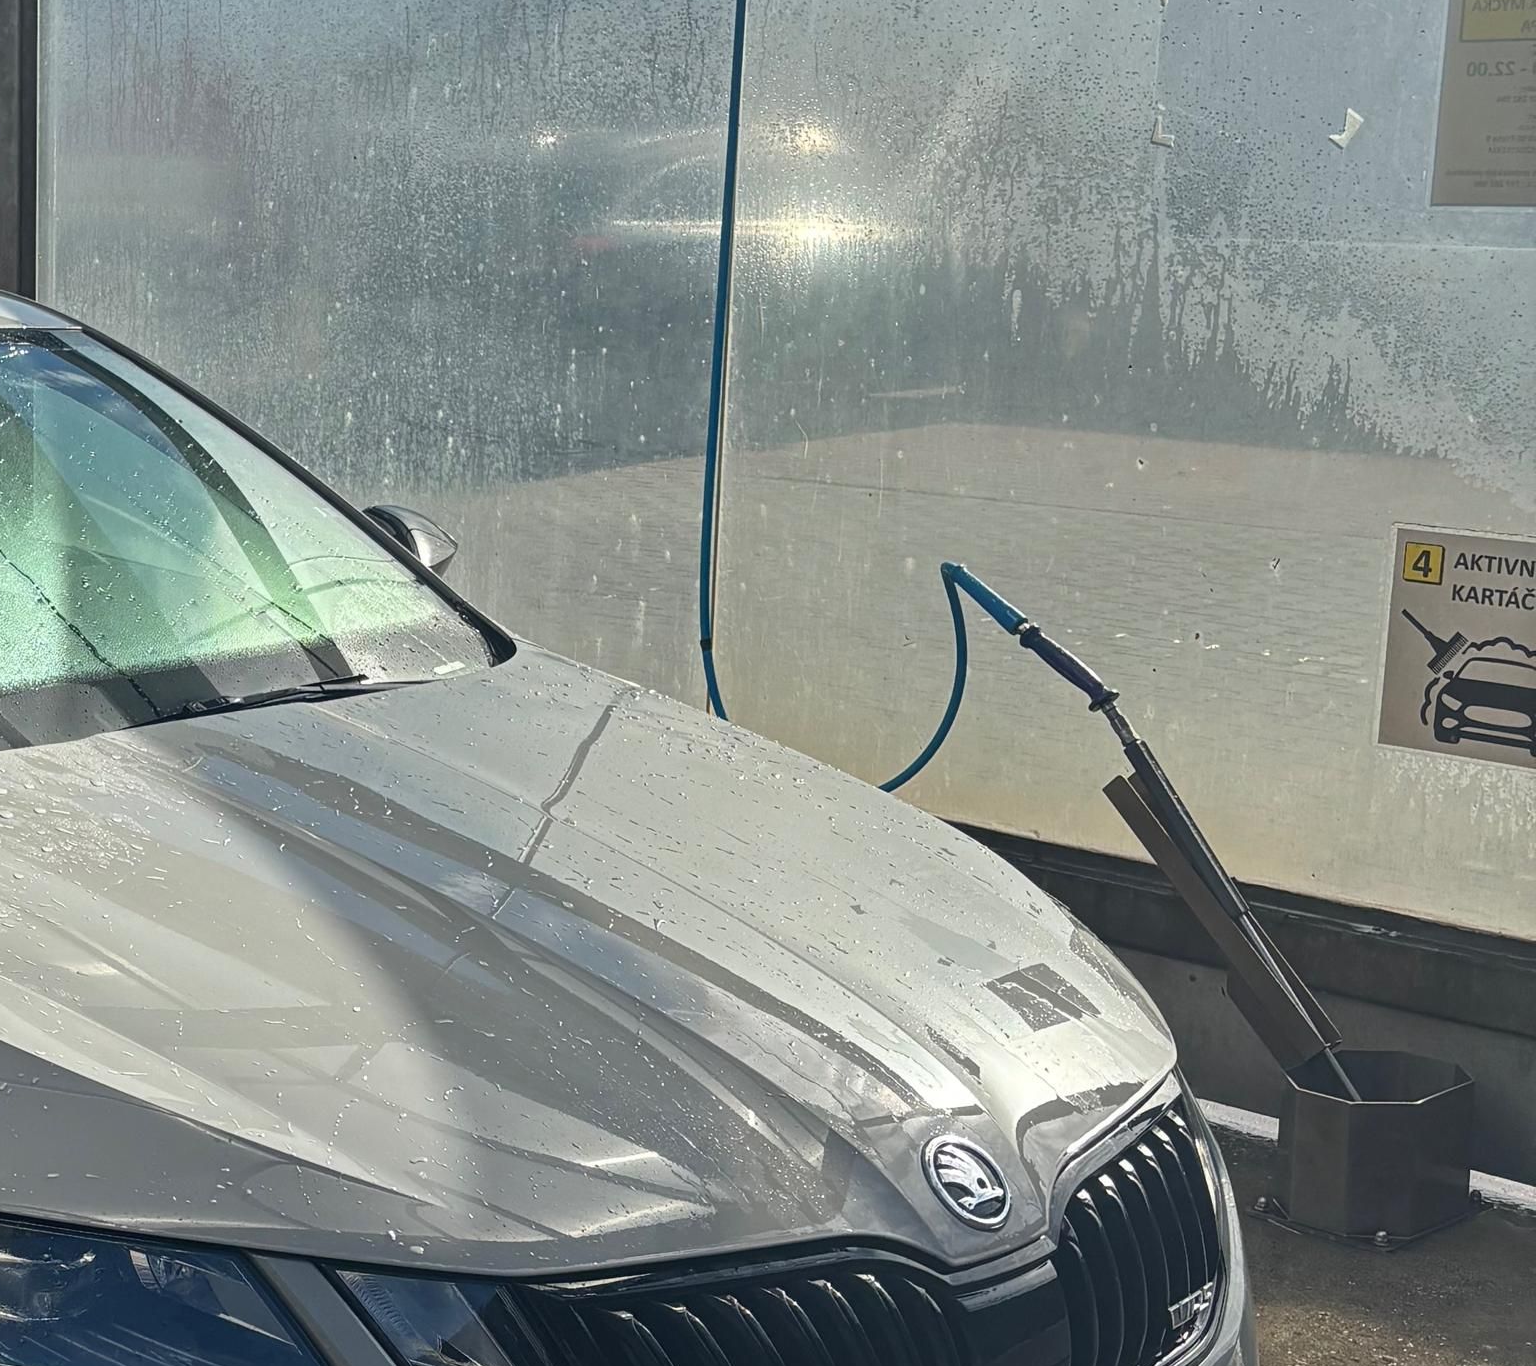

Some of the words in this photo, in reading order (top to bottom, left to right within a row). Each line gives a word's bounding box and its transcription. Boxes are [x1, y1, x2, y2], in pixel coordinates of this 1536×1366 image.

[1412, 550, 1432, 578] 4
[1454, 552, 1536, 578] AKTIVN
[1452, 584, 1536, 611] KARTÁČ
